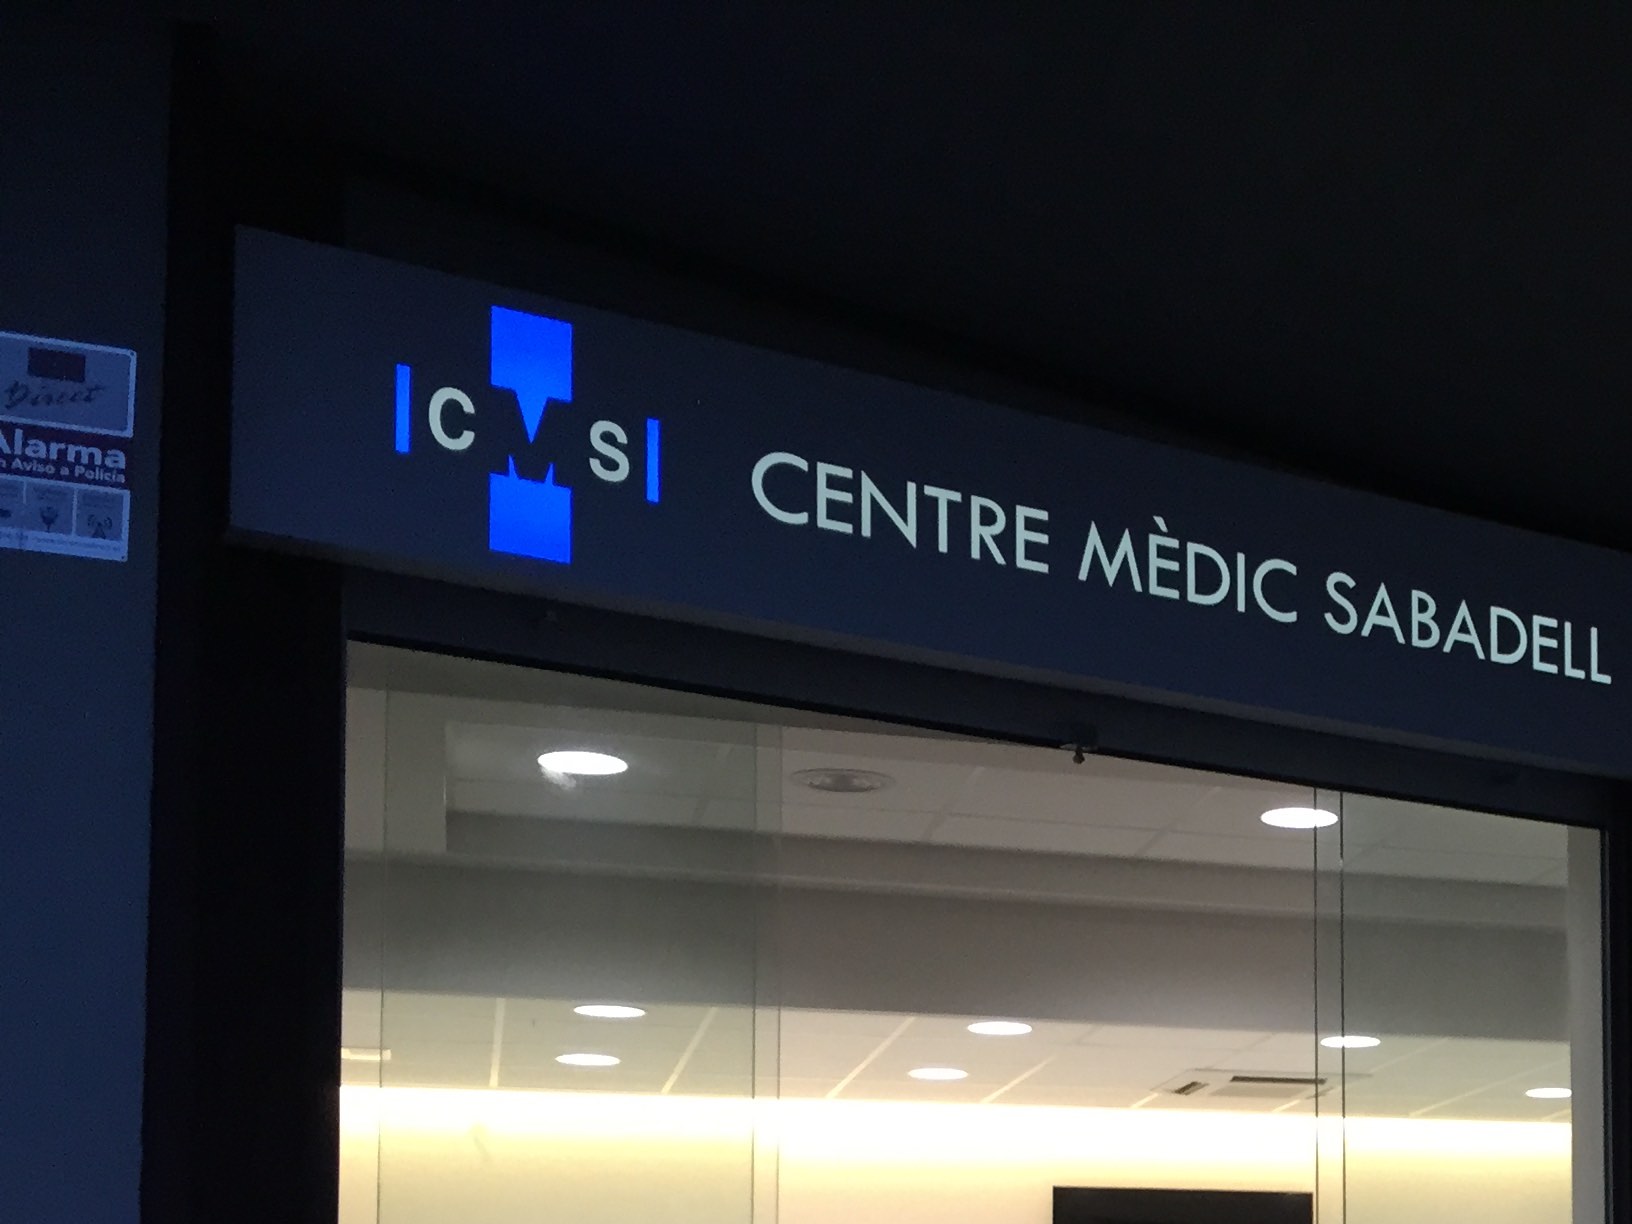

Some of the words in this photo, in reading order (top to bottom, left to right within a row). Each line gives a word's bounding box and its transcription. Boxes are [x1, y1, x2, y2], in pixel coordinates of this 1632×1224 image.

[11, 457, 56, 475] Aviso
[60, 465, 70, 476] a
[750, 450, 1050, 575] CENTRE
[1076, 514, 1299, 624] MÈDIC
[1323, 570, 1613, 686] SABADELL
